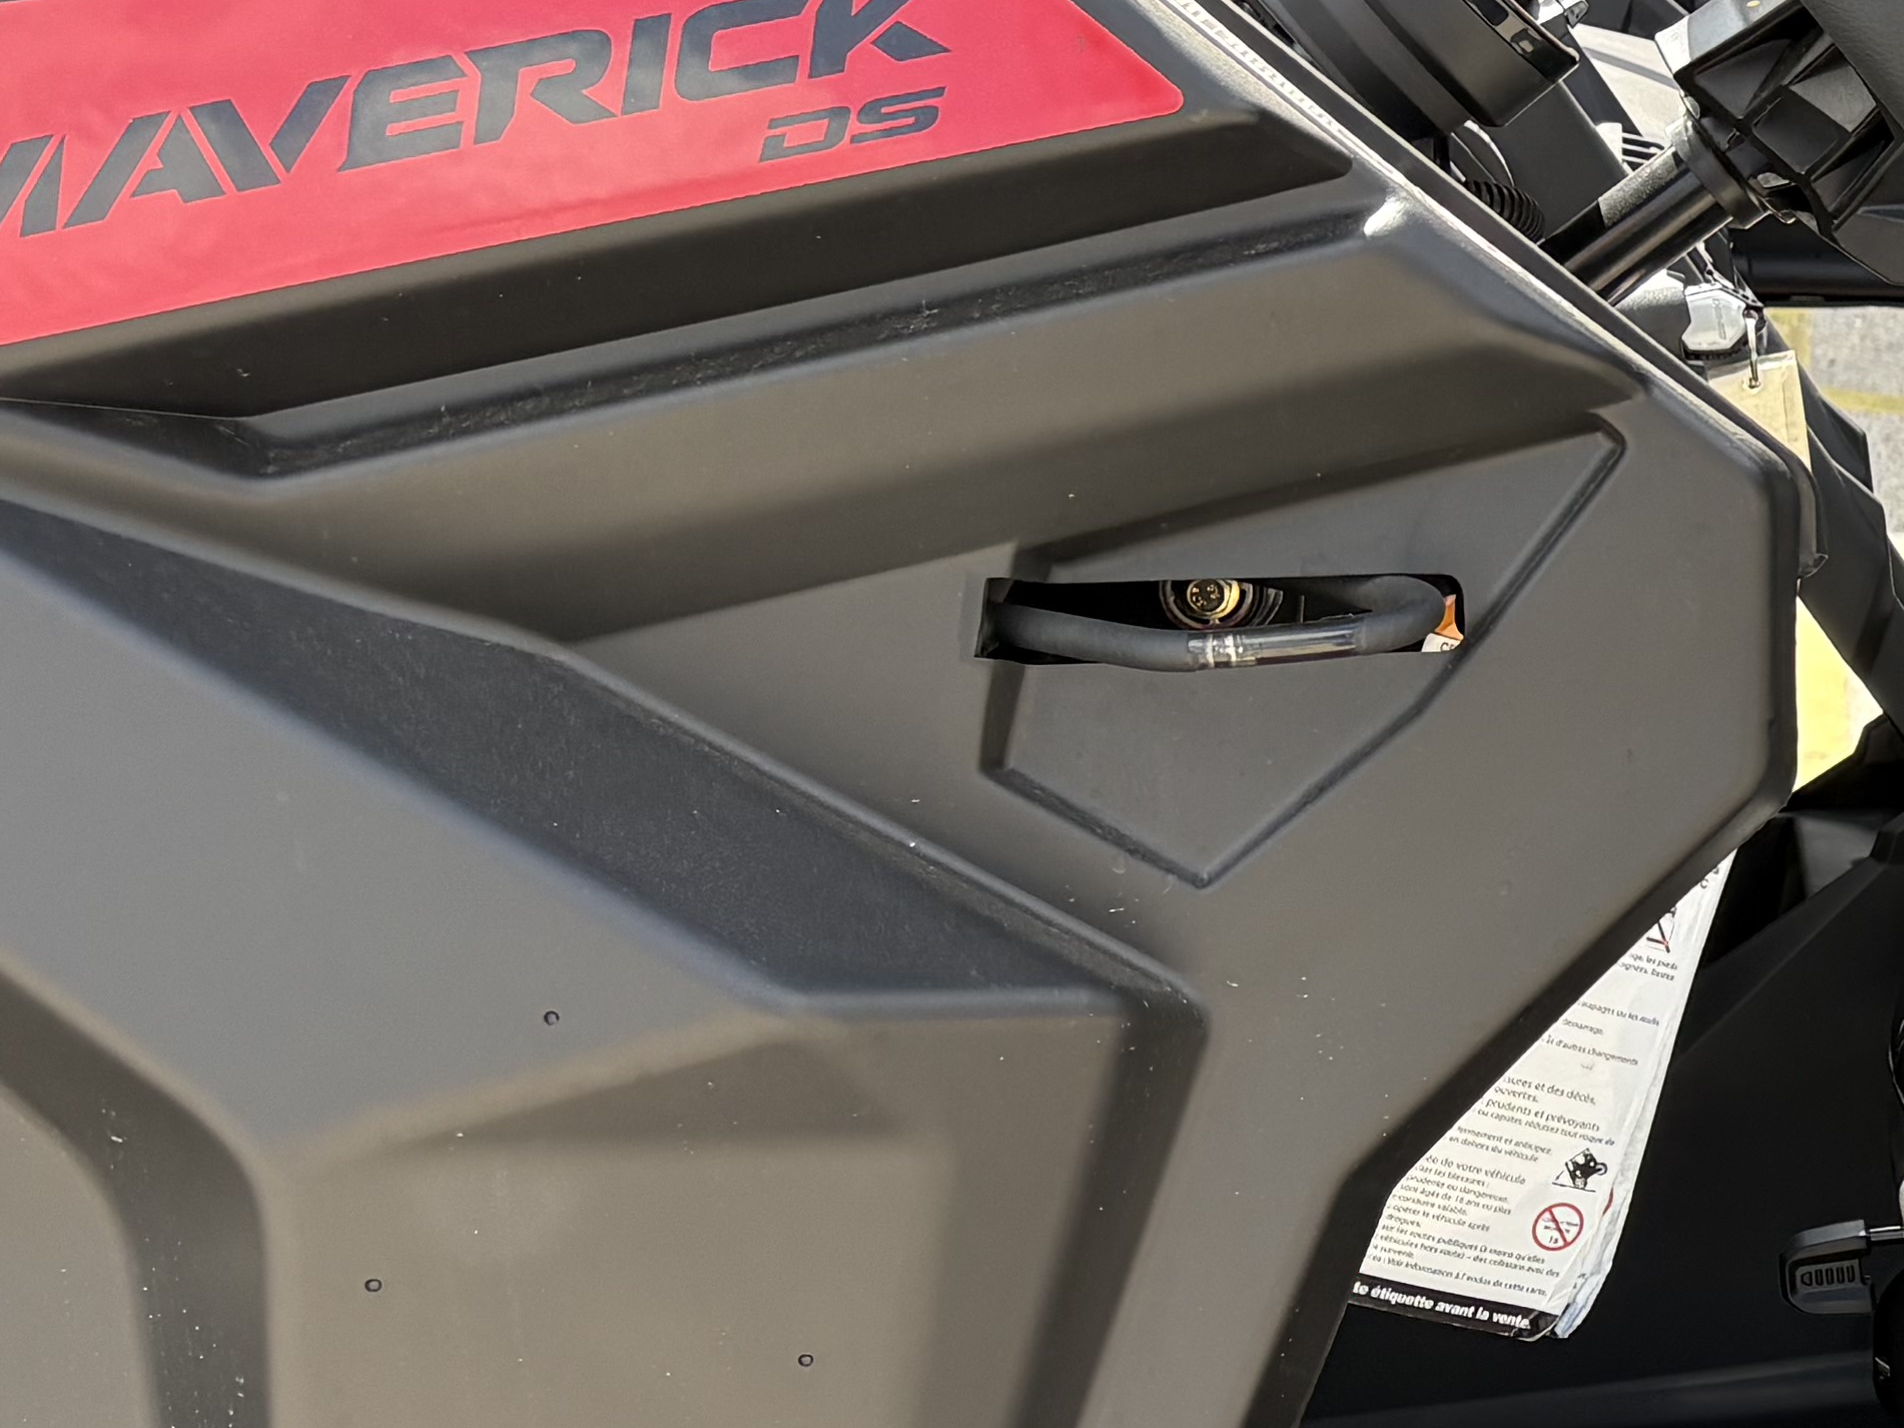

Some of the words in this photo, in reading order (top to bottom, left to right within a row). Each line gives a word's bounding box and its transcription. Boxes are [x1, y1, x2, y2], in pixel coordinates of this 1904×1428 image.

[759, 86, 947, 163] DS
[1547, 1085, 1565, 1097] des
[1370, 1285, 1435, 1310] étiquette
[1435, 1302, 1475, 1320] avant
[1476, 1308, 1489, 1321] la
